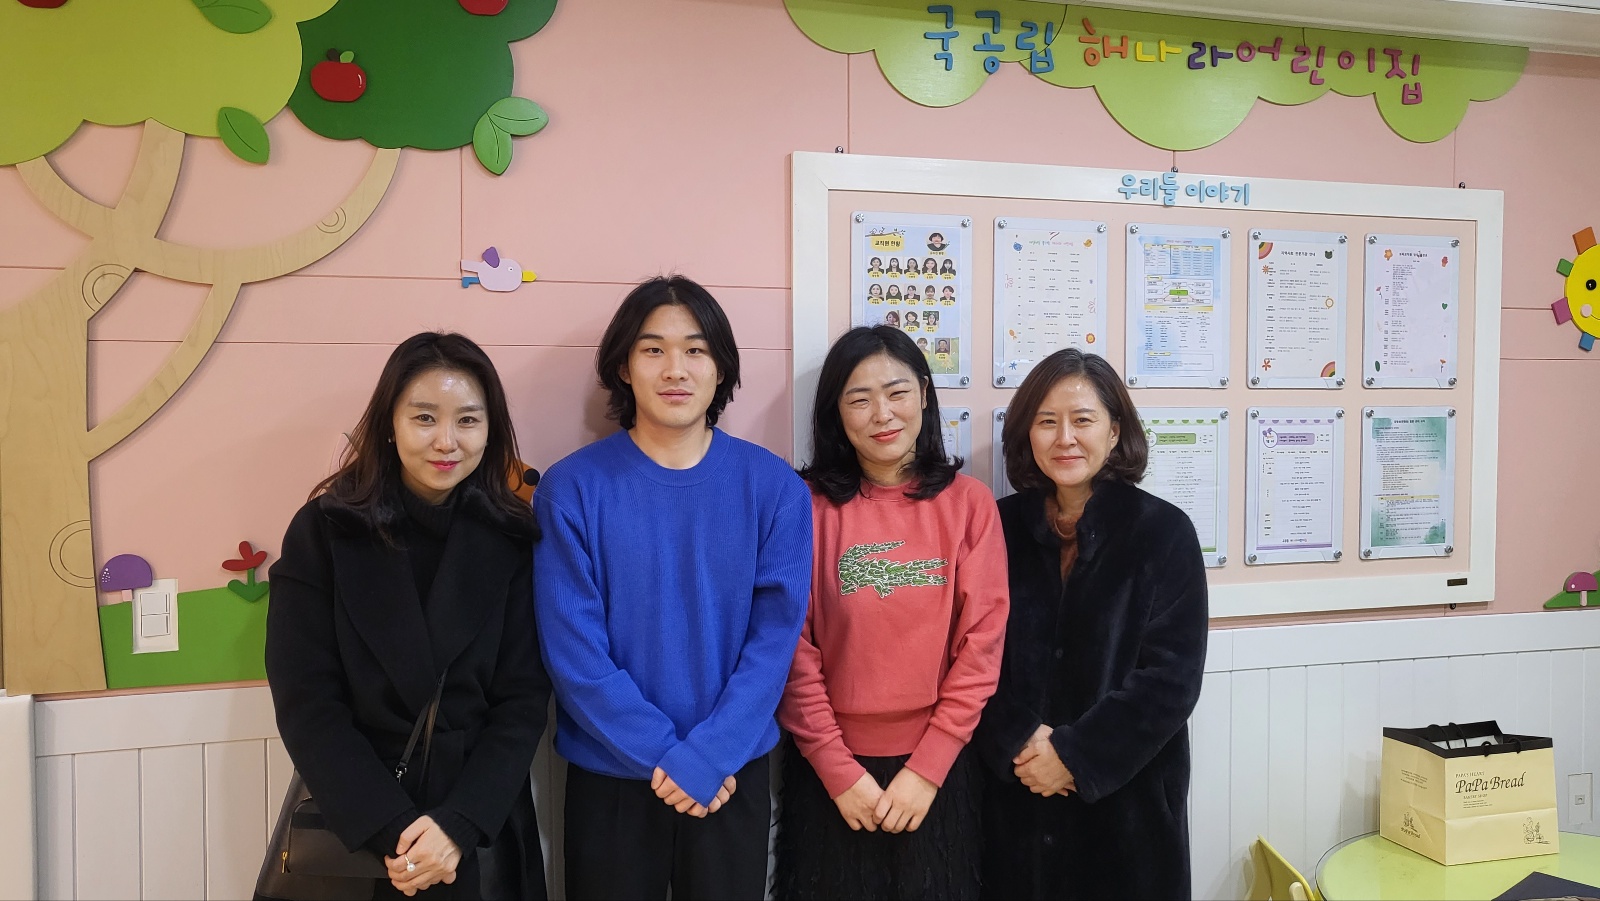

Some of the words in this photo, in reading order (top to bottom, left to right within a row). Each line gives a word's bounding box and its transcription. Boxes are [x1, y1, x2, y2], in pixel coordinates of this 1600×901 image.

[924, 5, 1055, 74] 국공립
[1118, 172, 1180, 206] 우리들
[1185, 179, 1250, 206] 이야기
[1455, 778, 1488, 794] PaPa
[1490, 771, 1526, 790] Bread
